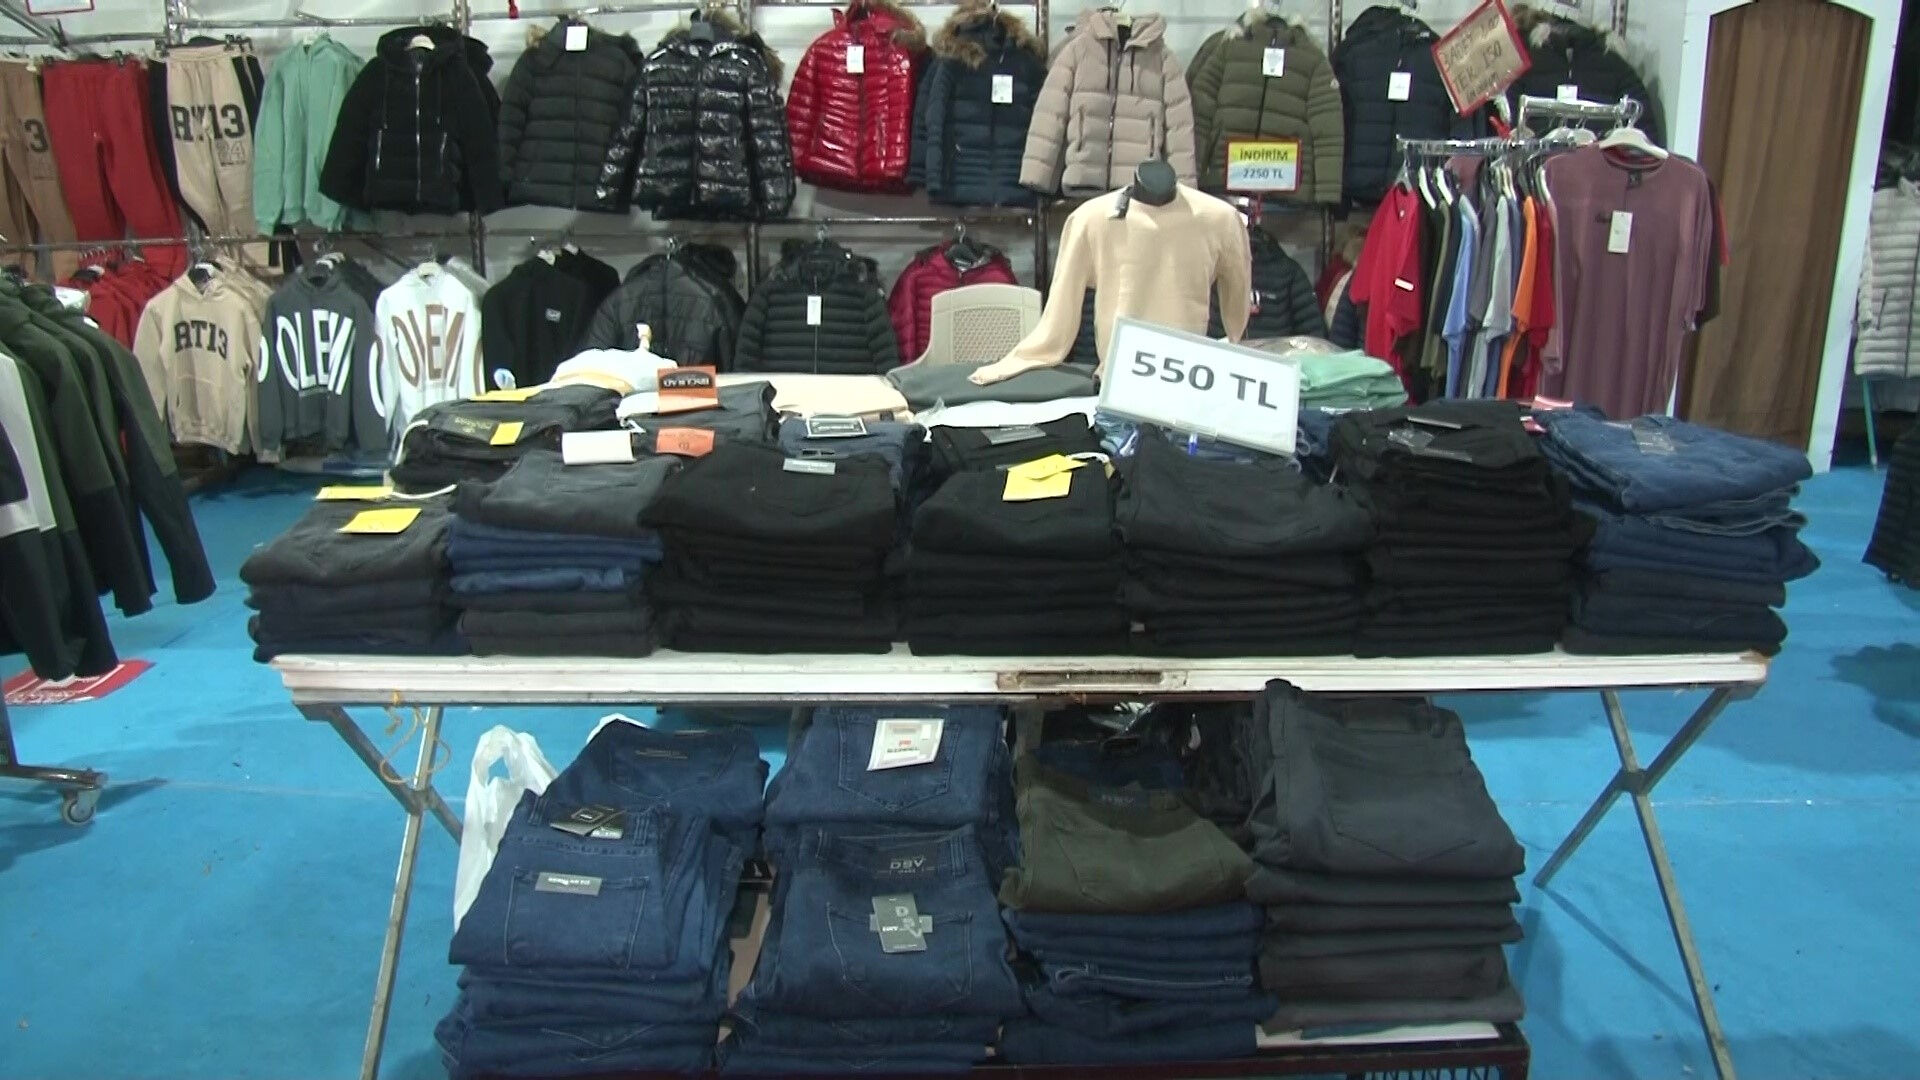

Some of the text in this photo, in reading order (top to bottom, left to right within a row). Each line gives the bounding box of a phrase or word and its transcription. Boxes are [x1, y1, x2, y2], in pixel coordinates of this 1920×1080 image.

[1239, 147, 1289, 162] İNDİRİM
[1242, 168, 1284, 180] 2250 TL
[174, 319, 229, 360] RT13
[1131, 350, 1278, 411] 550 TL
